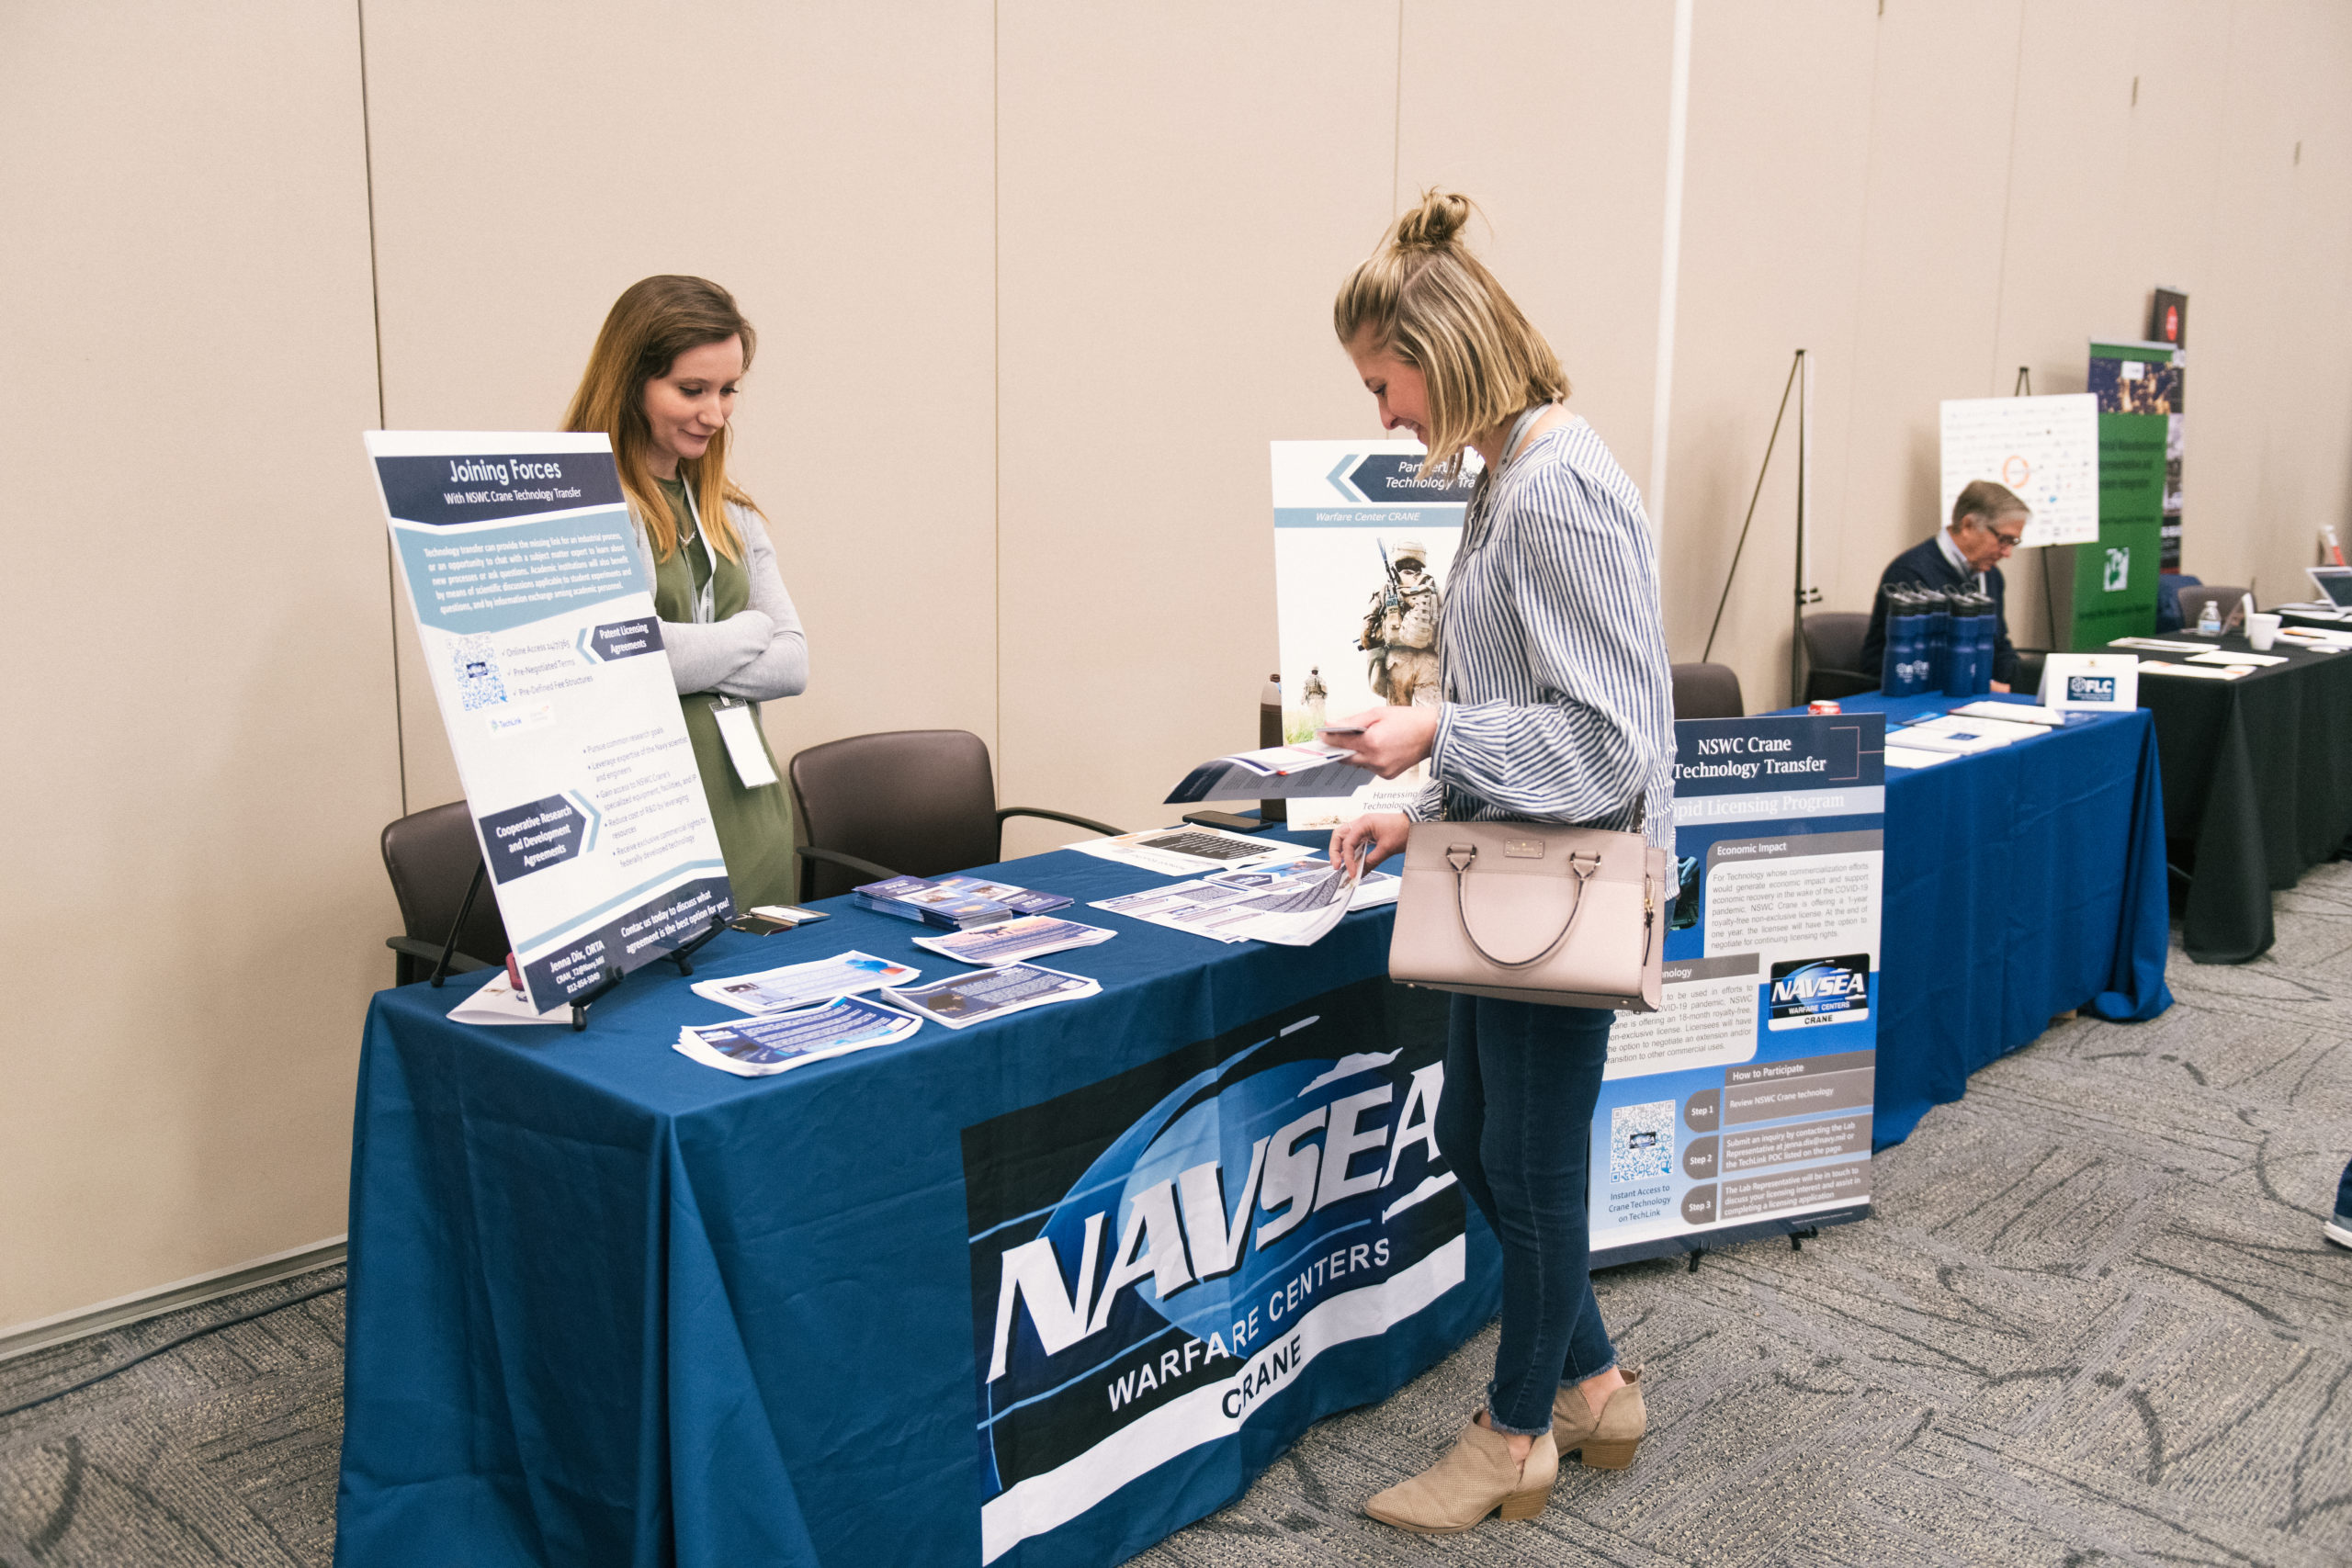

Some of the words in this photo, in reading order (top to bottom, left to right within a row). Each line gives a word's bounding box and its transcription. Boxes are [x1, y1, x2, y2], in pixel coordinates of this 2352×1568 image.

[450, 459, 508, 485] Joining
[510, 459, 562, 479] Forces
[444, 491, 465, 504] With
[465, 491, 490, 502] NSWC
[490, 491, 513, 502] Crane
[513, 489, 553, 501] Technology
[553, 487, 581, 498] Transfer
[1316, 512, 1352, 522] Warfare
[1354, 512, 1386, 522] Center
[1388, 512, 1421, 522] CRANE
[599, 627, 620, 638] Patent
[619, 623, 649, 636] Licensing
[610, 639, 646, 655] Agreements
[2085, 680, 2112, 694] FLC
[1698, 738, 1743, 754] NSWC
[1747, 737, 1791, 752] Crane
[1673, 761, 1759, 778] Technology
[1764, 755, 1826, 773] Transfer
[1673, 800, 1702, 820] pid
[1708, 796, 1778, 815] Licensing
[1782, 795, 1844, 812] Program
[496, 817, 540, 837] Cooperative
[539, 805, 571, 822] Research
[508, 838, 524, 852] and
[523, 824, 571, 847] Development
[524, 844, 566, 866] Agreements
[1717, 843, 1756, 855] Economic
[1758, 842, 1786, 853] Impact
[1713, 874, 1724, 882] For
[1726, 872, 1764, 880] Technology
[1849, 863, 1869, 871] efforts
[1713, 884, 1733, 893] would
[1736, 882, 1765, 892] generate
[1769, 880, 1800, 888] economic
[1804, 876, 1826, 886] impact
[1844, 874, 1868, 882] support
[642, 918, 651, 927] us
[650, 910, 669, 923] today
[668, 907, 676, 916] to
[675, 897, 696, 912] discuss
[695, 890, 711, 903] what
[626, 931, 659, 953] agreement
[658, 928, 665, 937] is
[664, 924, 676, 934] the
[674, 917, 689, 930] best
[688, 909, 707, 924] option
[707, 905, 716, 915] for
[716, 897, 729, 912] you!
[549, 956, 571, 972] Jenna
[584, 940, 605, 955] ORTA
[1661, 968, 1691, 978] nology
[1771, 973, 1865, 1003] NAVSEA
[1788, 1004, 1819, 1016] WARFARE
[1821, 1000, 1850, 1011] CENTERS
[1804, 1015, 1834, 1025] CRANE
[1607, 1044, 1617, 1053] he
[1619, 1043, 1640, 1052] option
[1651, 1037, 1682, 1047] negotiate
[1695, 1032, 1728, 1041] extension
[1730, 1028, 1751, 1037] and/or
[1646, 1050, 1665, 1058] other
[1667, 1044, 1705, 1055] commercial
[1732, 1071, 1750, 1080] How
[1752, 1069, 1761, 1077] to
[1762, 1065, 1804, 1076] Participate
[1729, 1099, 1753, 1108] Review
[1754, 1094, 1775, 1104] NSWC
[1776, 1093, 1796, 1101] Crane
[1797, 1088, 1833, 1098] technology
[1691, 1108, 1707, 1116] Step
[1709, 1105, 1713, 1113] 1
[1726, 1137, 1750, 1147] Submit
[1761, 1133, 1784, 1142] inquiry
[1785, 1131, 1794, 1139] by
[1795, 1126, 1830, 1136] contacting
[1831, 1123, 1842, 1132] the
[1843, 1122, 1855, 1130] Lab
[1690, 1156, 1705, 1165] Step
[1706, 1154, 1712, 1162] 2
[1725, 1145, 1774, 1158] Representative
[1725, 1160, 1736, 1168] the
[1738, 1156, 1766, 1166] TechLink
[1768, 1152, 1782, 1161] POC
[1783, 1149, 1802, 1159] listed
[1813, 1146, 1824, 1155] the
[1724, 1196, 1748, 1205] discuss
[1749, 1193, 1765, 1202] your
[1766, 1188, 1794, 1198] licensing
[1795, 1183, 1820, 1193] interest
[1821, 1180, 1834, 1190] and
[1835, 1178, 1853, 1187] assist
[1853, 1176, 1860, 1184] in
[1725, 1186, 1737, 1194] The
[1738, 1183, 1751, 1192] Lab
[1752, 1177, 1800, 1190] Representative
[1801, 1173, 1813, 1182] will
[1814, 1172, 1823, 1180] be
[1831, 1168, 1850, 1177] touch
[1610, 1190, 1635, 1200] Instant
[1636, 1187, 1660, 1195] Access
[1608, 1203, 1629, 1213] Crane
[1630, 1197, 1670, 1208] Technology
[1689, 1203, 1704, 1212] Step
[1705, 1200, 1711, 1208] 3
[1724, 1203, 1761, 1215] completing
[1769, 1198, 1797, 1208] licensing
[1798, 1192, 1834, 1204] application
[986, 1060, 1446, 1384] NAVSEA
[1629, 1208, 1660, 1220] TechLink
[1108, 1305, 1260, 1413] WARFARE
[1269, 1237, 1391, 1322] CENTERS
[1221, 1333, 1302, 1419] CRANE
